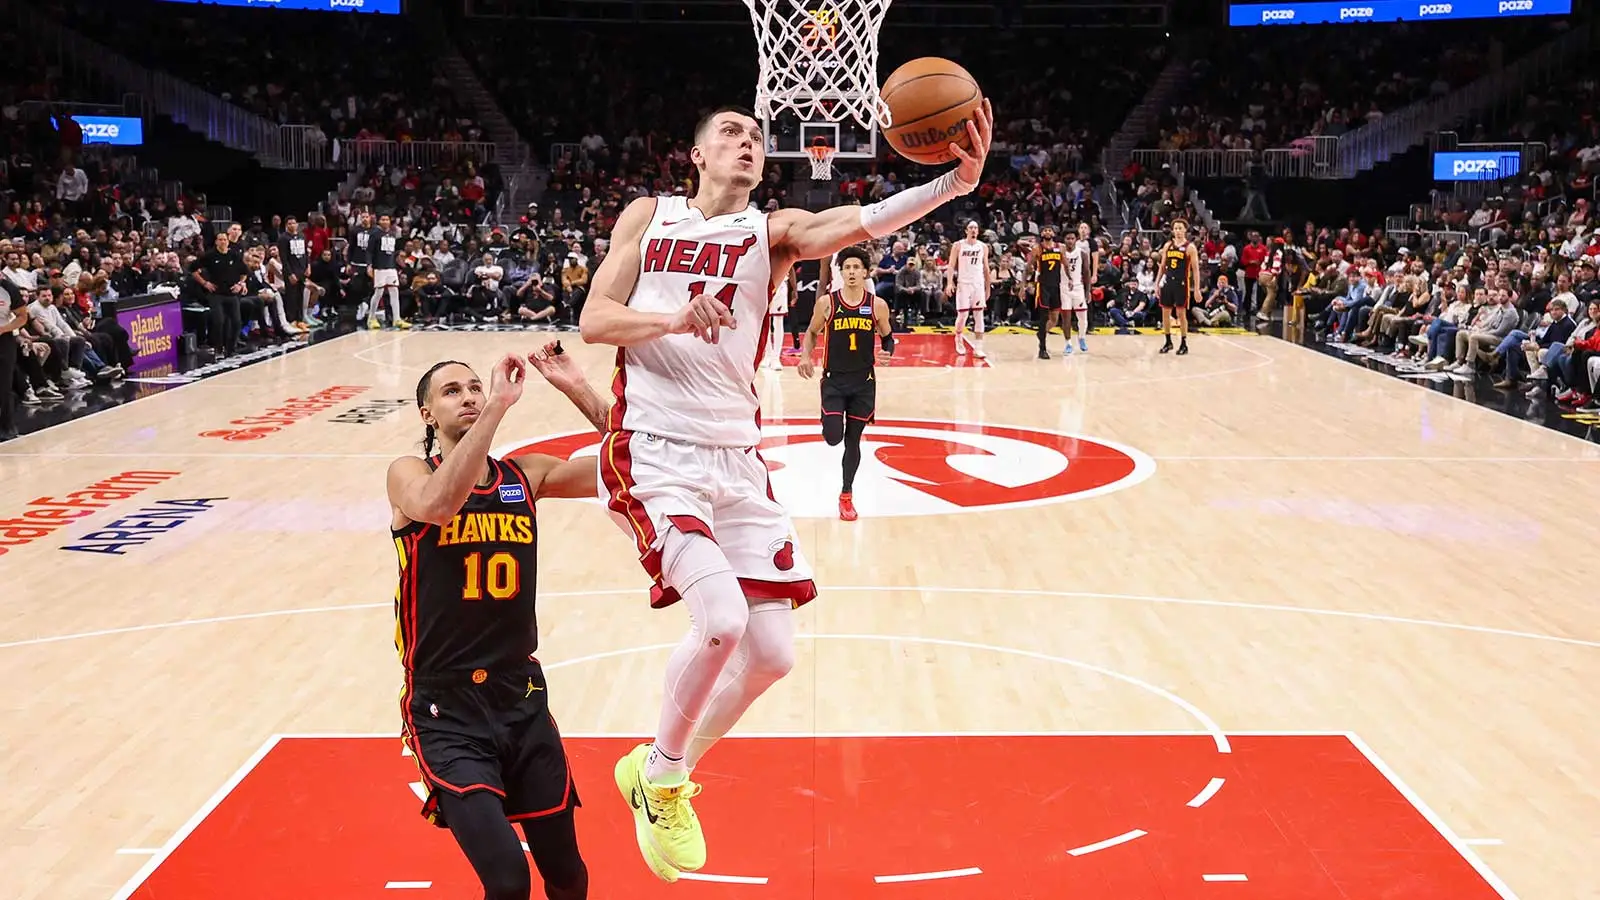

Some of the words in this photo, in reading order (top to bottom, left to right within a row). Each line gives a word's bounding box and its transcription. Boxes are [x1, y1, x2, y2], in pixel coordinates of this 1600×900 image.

[1340, 7, 1373, 19] paze
[1419, 3, 1452, 16] paze
[1498, 0, 1533, 13] paze
[1262, 10, 1295, 21] paze
[80, 123, 119, 137] aze
[644, 233, 757, 278] HEAT
[971, 257, 978, 265] 11
[1048, 260, 1056, 271] 7
[1171, 259, 1178, 269] 5
[131, 312, 163, 343] planet
[833, 317, 873, 331] HAWKS
[137, 335, 172, 357] fitness
[849, 332, 858, 351] 1
[58, 496, 230, 555] ARENA
[437, 512, 534, 547] HAWKS
[462, 551, 520, 600] 10
